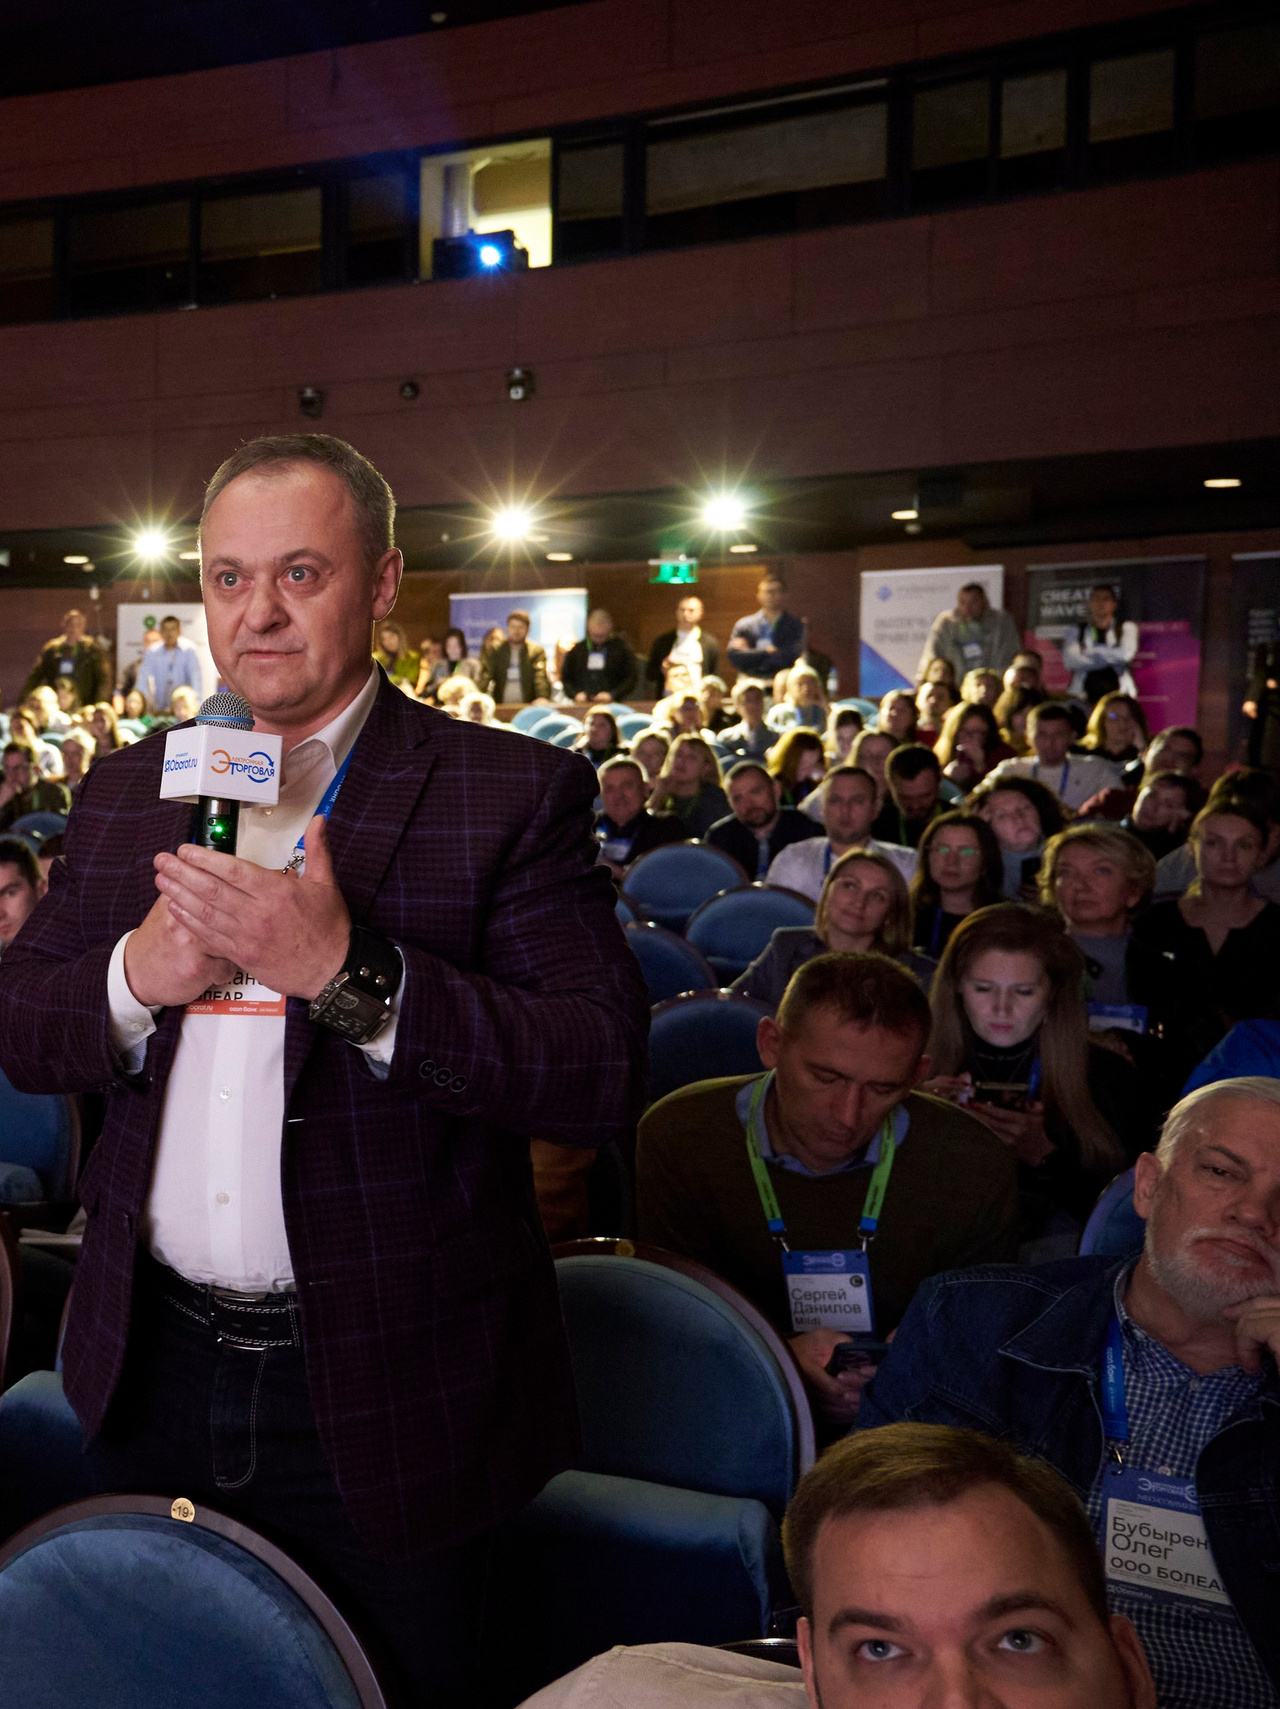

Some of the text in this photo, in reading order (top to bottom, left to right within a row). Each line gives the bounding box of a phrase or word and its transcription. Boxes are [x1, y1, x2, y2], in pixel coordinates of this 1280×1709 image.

[228, 762, 275, 777] ТОРГОВЛЯ
[791, 1288, 847, 1303] Сергей
[793, 1301, 862, 1317] Данилов
[176, 1505, 190, 1518] 19
[1112, 1533, 1174, 1560] Олег
[1110, 1556, 1151, 1575] ООО
